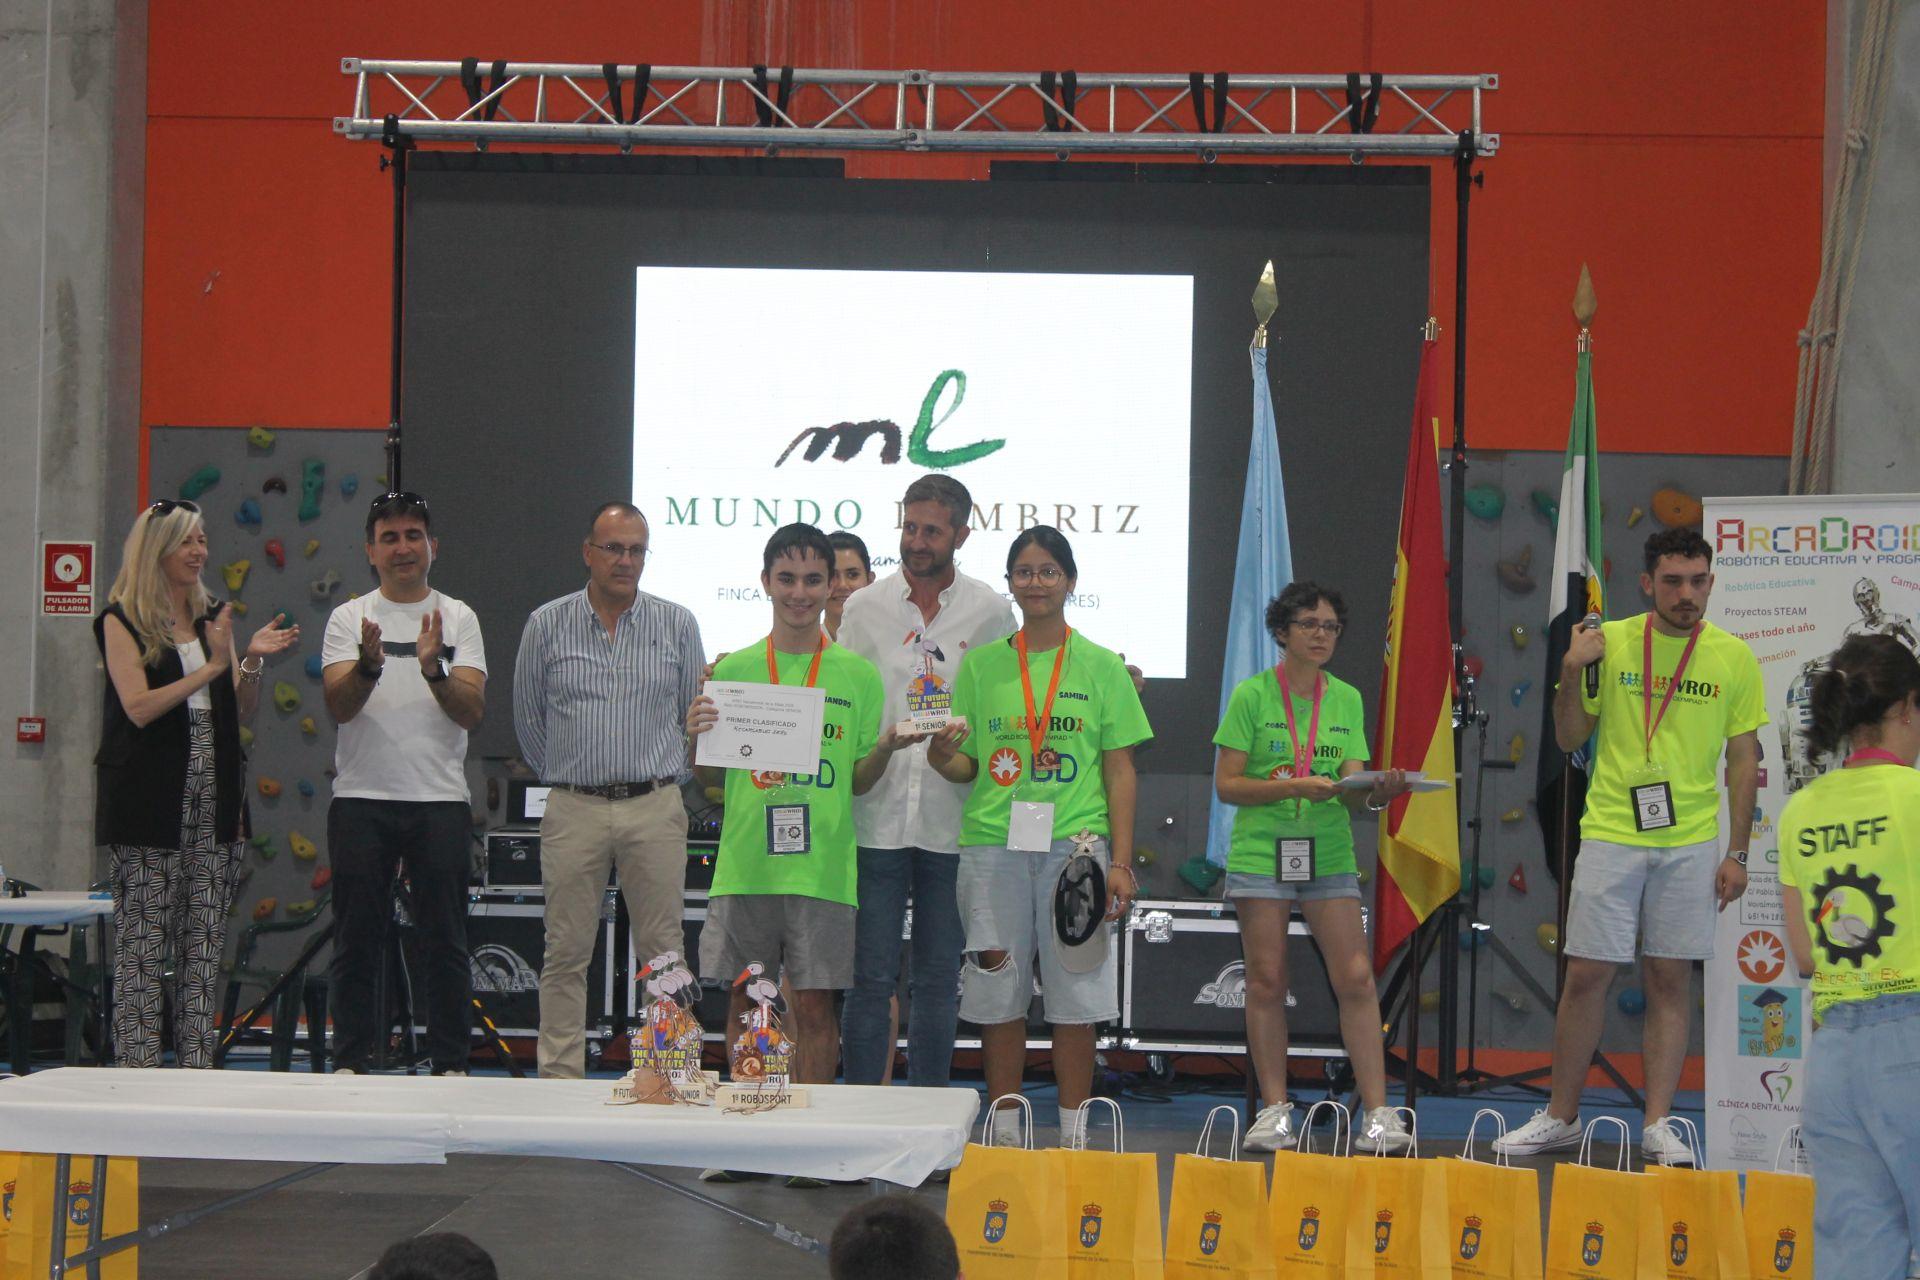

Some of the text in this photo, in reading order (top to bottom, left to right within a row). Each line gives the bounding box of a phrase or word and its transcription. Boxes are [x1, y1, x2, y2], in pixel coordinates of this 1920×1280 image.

[666, 497, 1141, 534] MUNDO LMBRIZ
[1785, 554, 1857, 566] EDUCATIVA
[1862, 554, 1872, 564] Y
[1877, 553, 1920, 565] PROGR
[1725, 577, 1816, 593] Robótica Educativa
[717, 587, 761, 601] FINCA
[47, 597, 88, 605] PULSADOR
[57, 605, 90, 613] ALARMA
[1724, 607, 1807, 618] Proyectos STEAM
[1762, 626, 1784, 638] todo
[1786, 625, 1796, 635] el
[1797, 623, 1816, 633] año
[908, 692, 951, 704] THE FUTURE
[1058, 691, 1089, 702] SAMIRA
[725, 716, 797, 728] PRIMER CLASIFICADO
[921, 720, 947, 731] SENIOR
[1797, 815, 1889, 858] STAFF
[740, 1092, 792, 1105] ROBOSPORT
[1717, 1100, 1803, 1114] CLÍNICA DENTAL NAV
